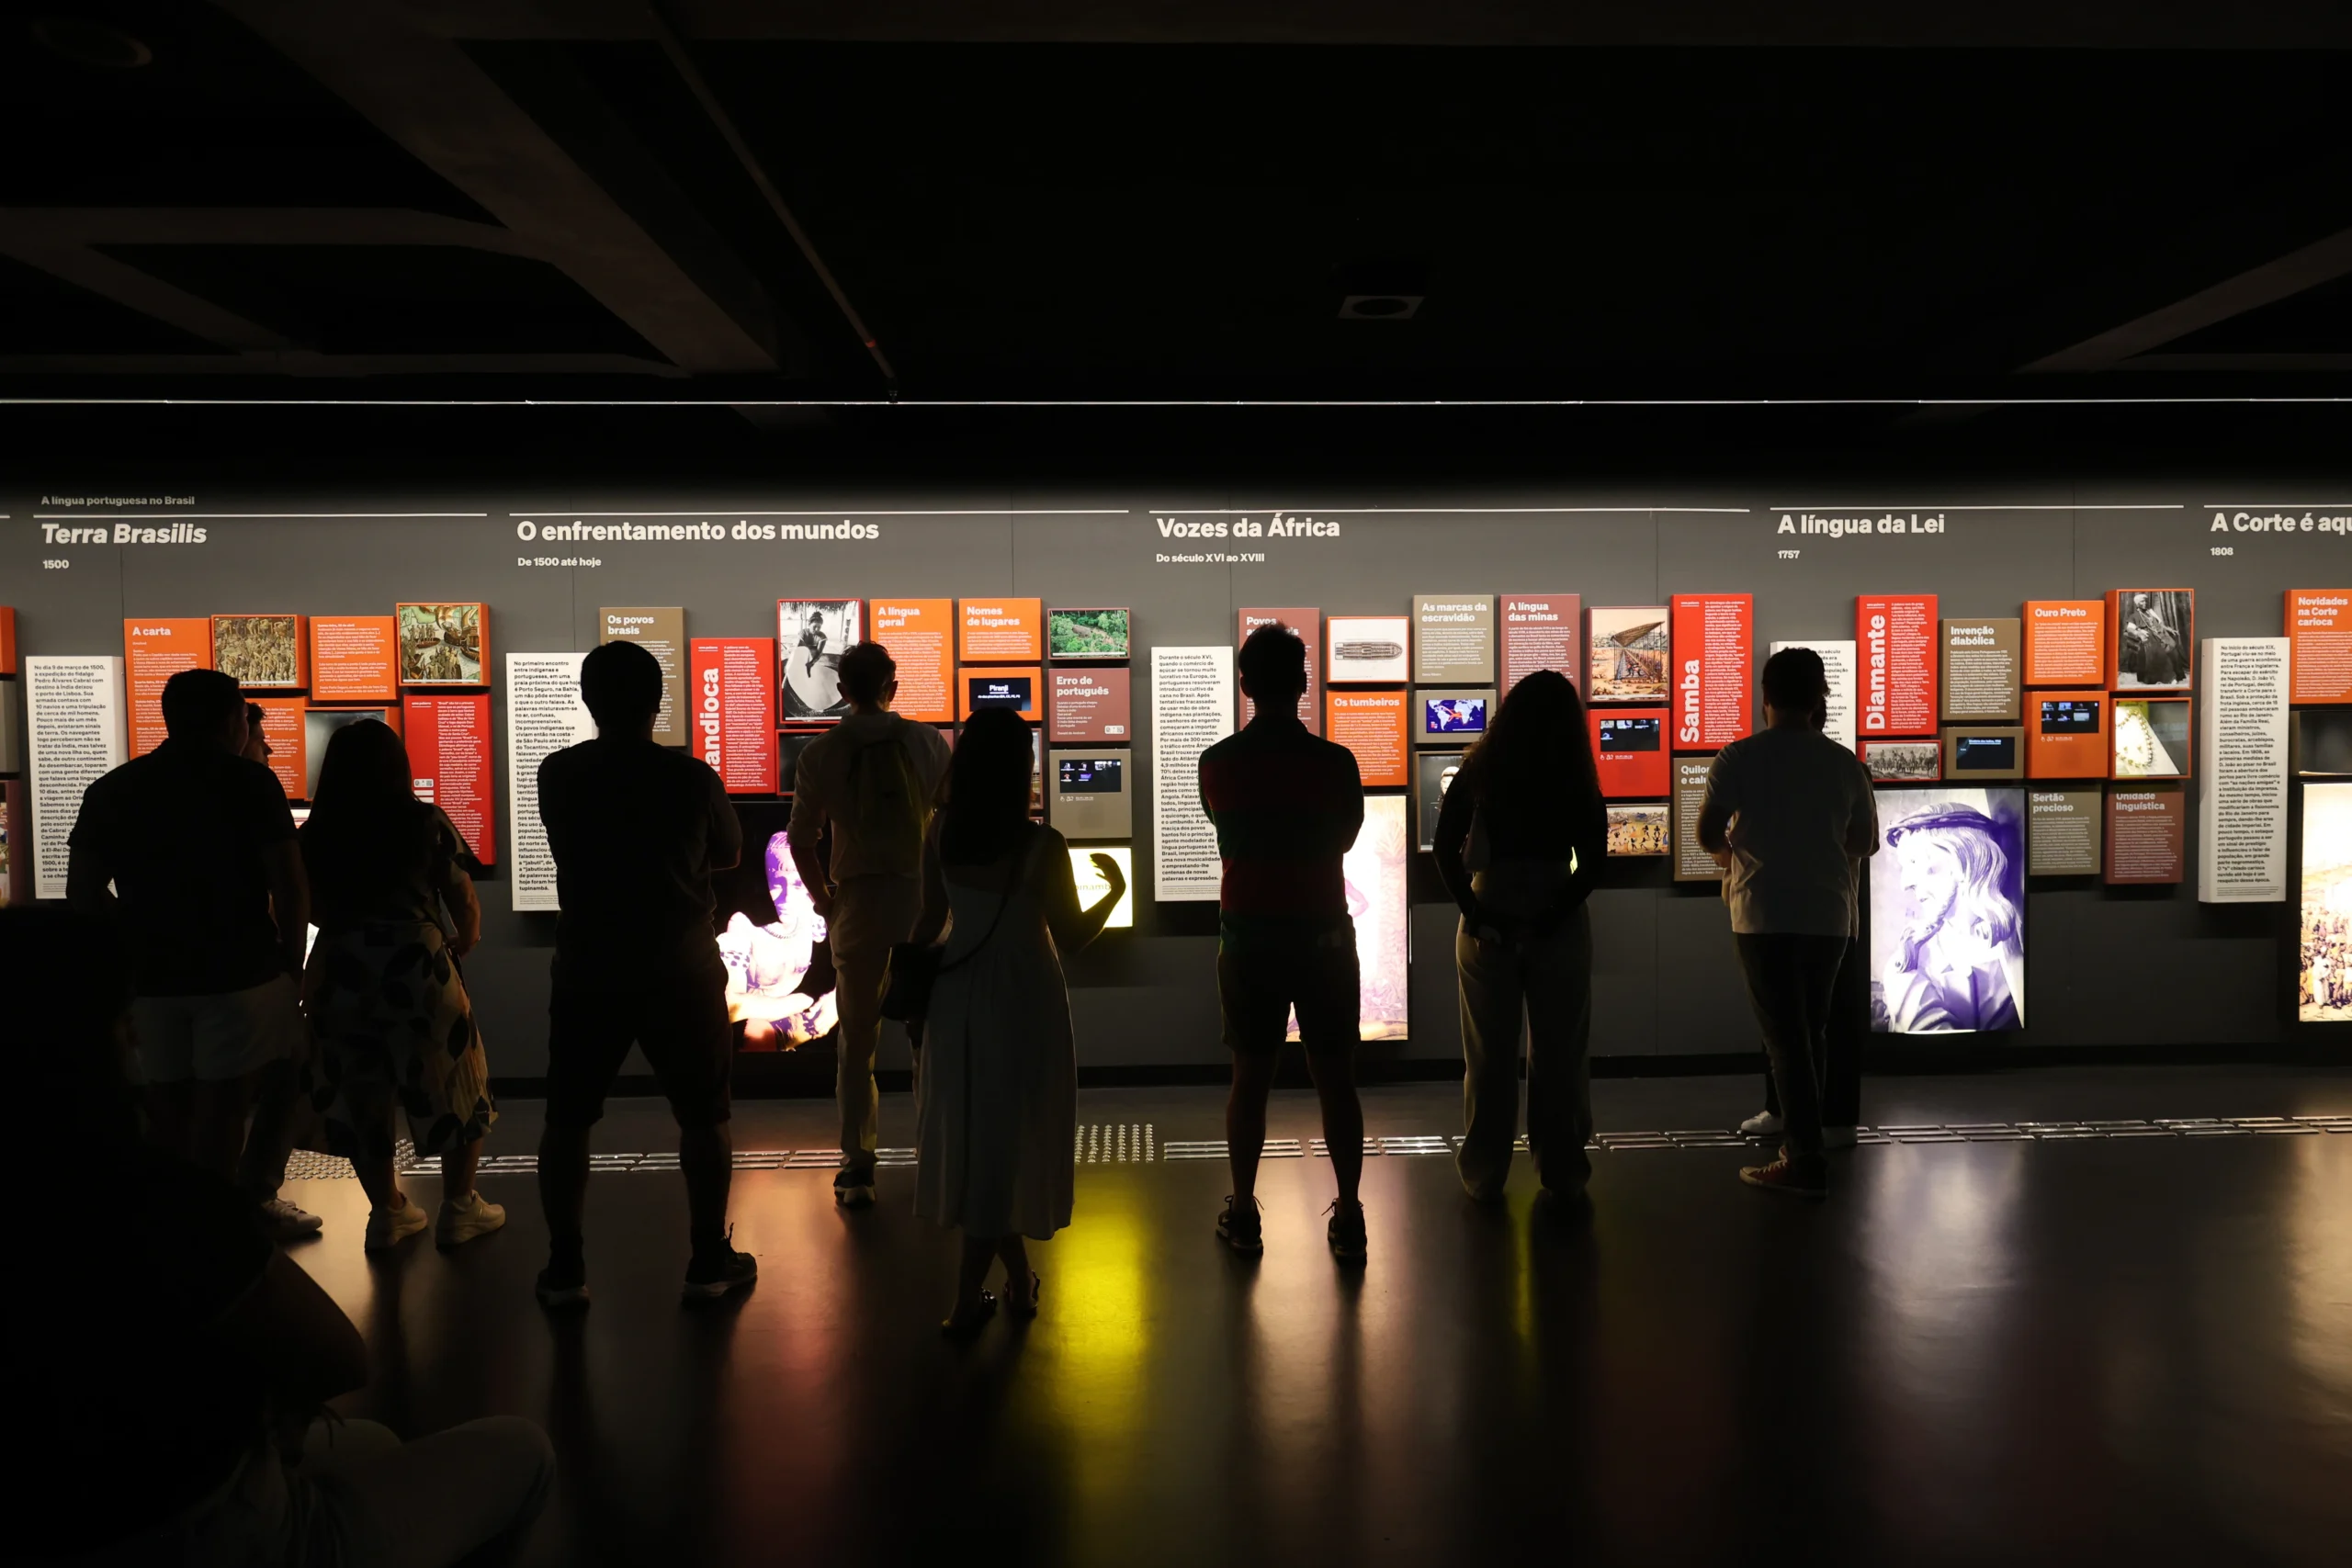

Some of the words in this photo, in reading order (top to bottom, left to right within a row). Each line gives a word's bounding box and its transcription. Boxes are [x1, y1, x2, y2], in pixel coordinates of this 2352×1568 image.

[40, 496, 51, 505] A
[51, 496, 85, 507] língua
[86, 496, 148, 507] portuguesa
[164, 496, 195, 505] Brasil
[1156, 518, 1228, 538] Vozes
[1232, 517, 1262, 537] da
[1267, 512, 1340, 537] África
[1777, 514, 1796, 534] A
[1801, 514, 1872, 538] língua
[1877, 513, 1905, 534] da
[1911, 513, 1945, 534] Lei
[2211, 513, 2229, 532] A
[2233, 512, 2296, 532] Corte
[2300, 513, 2314, 532] é
[41, 524, 108, 544] Terra
[113, 523, 207, 544] Brasilis
[517, 521, 537, 541] O
[541, 521, 726, 541] enfrentamento
[731, 520, 776, 540] dos
[781, 519, 879, 540] mundos
[1777, 550, 1801, 559] 1757
[2210, 547, 2233, 556] 1808
[517, 558, 532, 567] De
[533, 557, 560, 567] 1500
[560, 557, 578, 567] até
[579, 557, 602, 568] hoje
[1156, 553, 1170, 562] Do
[1171, 553, 1204, 562] século
[1205, 553, 1225, 562] XVI
[1239, 553, 1265, 562] XVIII
[42, 559, 70, 570] 1500
[2298, 596, 2348, 605] Novidades
[877, 606, 887, 615] A
[888, 606, 921, 619] língua
[967, 606, 1003, 615] Nomes
[1421, 603, 1435, 612] As
[1474, 603, 1487, 612] da
[1508, 602, 1517, 611] A
[1518, 602, 1549, 613] língua
[2034, 608, 2059, 617] Ouro
[2059, 608, 2086, 617] Preto
[2311, 606, 2338, 616] Corte
[607, 615, 622, 625] Os
[623, 616, 654, 627] povos
[877, 616, 905, 628] geral
[967, 616, 981, 626] de
[980, 616, 1021, 627] lugares
[1246, 616, 1276, 626] Povos
[1421, 613, 1476, 623] escravidão
[1508, 612, 1527, 622] das
[1528, 612, 1558, 621] minas
[2298, 616, 2334, 626] carioca
[132, 626, 141, 636] A
[142, 626, 172, 636] carta
[607, 625, 640, 635] brasis
[1951, 626, 1995, 637] Invenção
[1951, 635, 1995, 646] diabólica
[1866, 615, 1885, 729] Diamante
[1057, 676, 1079, 685] Erro
[1080, 675, 1092, 685] de
[1057, 685, 1109, 697] português
[1334, 697, 1349, 706] Os
[1349, 697, 1400, 706] tumbeiros
[1679, 660, 1700, 743] Samba
[699, 668, 720, 776] andioca
[1680, 765, 1710, 775] Quilo
[2032, 793, 2064, 802] Sertão
[2116, 793, 2155, 801] Unidade
[2032, 803, 2074, 814] precioso
[2116, 801, 2165, 812] linguística
